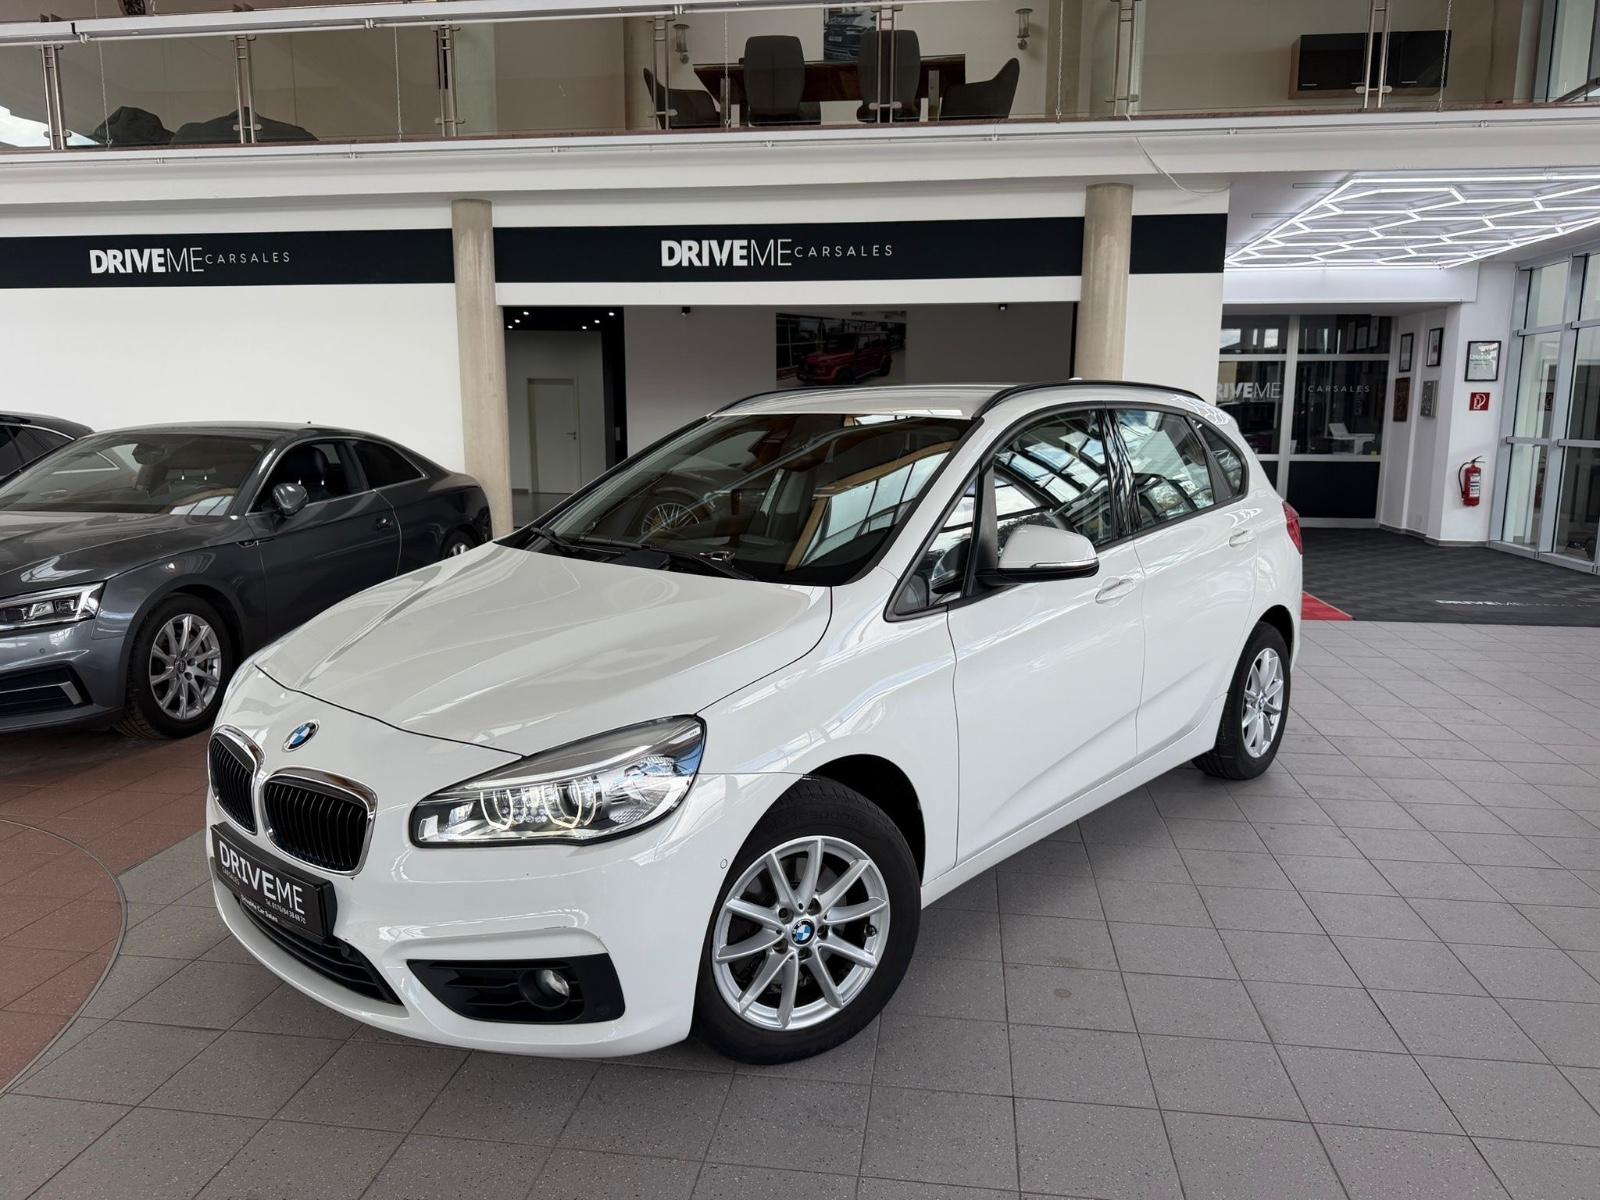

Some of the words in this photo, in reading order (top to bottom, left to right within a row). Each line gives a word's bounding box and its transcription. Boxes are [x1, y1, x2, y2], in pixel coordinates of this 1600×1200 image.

[205, 251, 291, 265] CARSALES
[794, 245, 893, 258] CARSALES
[1307, 384, 1371, 393] CARSALES
[219, 840, 305, 914] DRIVEME
